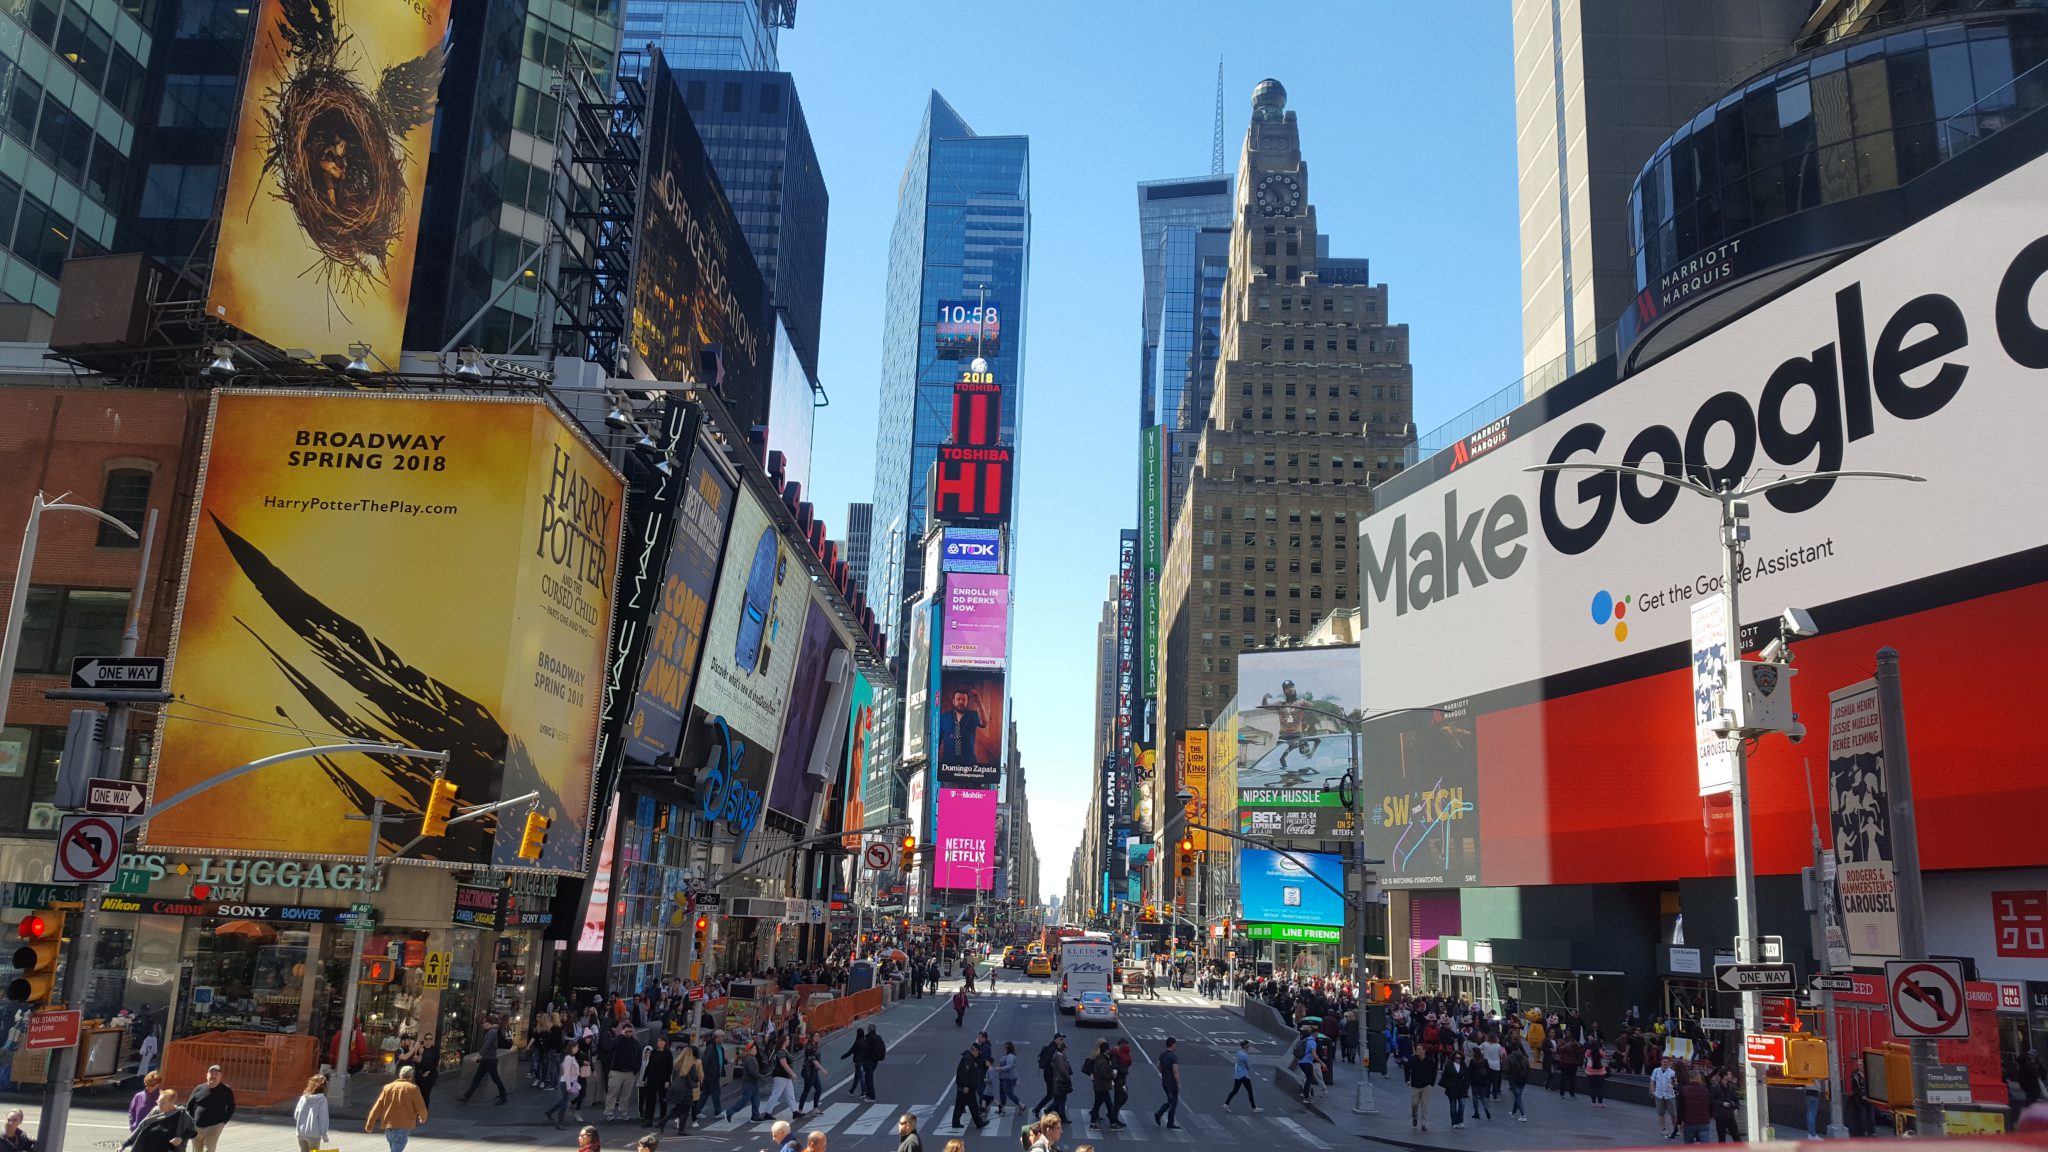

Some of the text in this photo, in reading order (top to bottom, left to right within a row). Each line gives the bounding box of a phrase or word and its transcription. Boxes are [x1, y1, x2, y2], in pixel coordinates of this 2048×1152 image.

[665, 170, 757, 367] OFFICE LOCATIONS
[1661, 240, 1740, 290] MARRIOTT
[1663, 263, 1730, 307] MARQUIS
[941, 306, 998, 324] 10:58
[492, 360, 551, 380] LAMAR
[963, 373, 993, 383] 2018
[955, 384, 1000, 392] TOSHIBA
[1471, 416, 1511, 444] MARRIOTT
[296, 430, 446, 450] BROADWAY
[1471, 431, 1506, 456] MARQUIS
[288, 451, 446, 471] SPRING 2018
[941, 448, 1009, 461] TOSHIBA
[1359, 489, 1529, 630] Make
[1539, 281, 1969, 555] Google
[548, 443, 613, 545] HARRY
[264, 496, 458, 516] HarryPotterThePlay.com
[537, 493, 608, 599] POTTER
[957, 543, 994, 556] TDK
[561, 573, 582, 595] AND THE
[1638, 538, 1834, 612] Get the Assistant
[542, 574, 598, 626] CURSED CHILD
[665, 574, 706, 636] COME
[98, 667, 154, 679] ONE WAY
[538, 652, 585, 687] BROADWAY
[711, 656, 729, 680] Discover
[534, 671, 584, 708] SPRING 2018
[643, 656, 689, 710] AWAY
[1444, 699, 1469, 710] MARRIOTT
[1834, 697, 1875, 720] JOSHUA HENRY
[1832, 713, 1879, 736] JESSIE MUELLER
[1832, 730, 1879, 751] RENÉE FLEMING
[1187, 754, 1204, 762] LION
[942, 763, 997, 773] Domingo Zapata
[1186, 763, 1206, 774] KING
[94, 789, 131, 804] ONE WAY
[1107, 771, 1115, 807] OATH
[1243, 790, 1320, 803] NIPSEY HUSSLE
[1252, 811, 1277, 822] BET
[945, 838, 985, 851] NETFLIX
[944, 851, 985, 863] NETFLIX
[122, 872, 139, 890] 7 Av
[1846, 868, 1885, 881] RODGERS &
[210, 885, 243, 901] NY
[513, 872, 558, 897] LUGGAGE
[1842, 881, 1893, 894] HAMMERSTEIN'S
[18, 887, 74, 906] W 46 St
[1844, 893, 1895, 913] CAROUSEL
[101, 898, 321, 920] Nikon Canon SONY BOWER
[359, 904, 368, 912] 46
[475, 913, 496, 925] LUGGAGE
[521, 914, 538, 923] SONY
[1282, 928, 1302, 937] LINE
[426, 953, 439, 984] ATM
[1740, 972, 1786, 982] ONE WAY
[2003, 987, 2017, 995] UNI
[2004, 997, 2019, 1005] QLO
[41, 1015, 68, 1023] STANDING
[1944, 1074, 1963, 1082] Square
